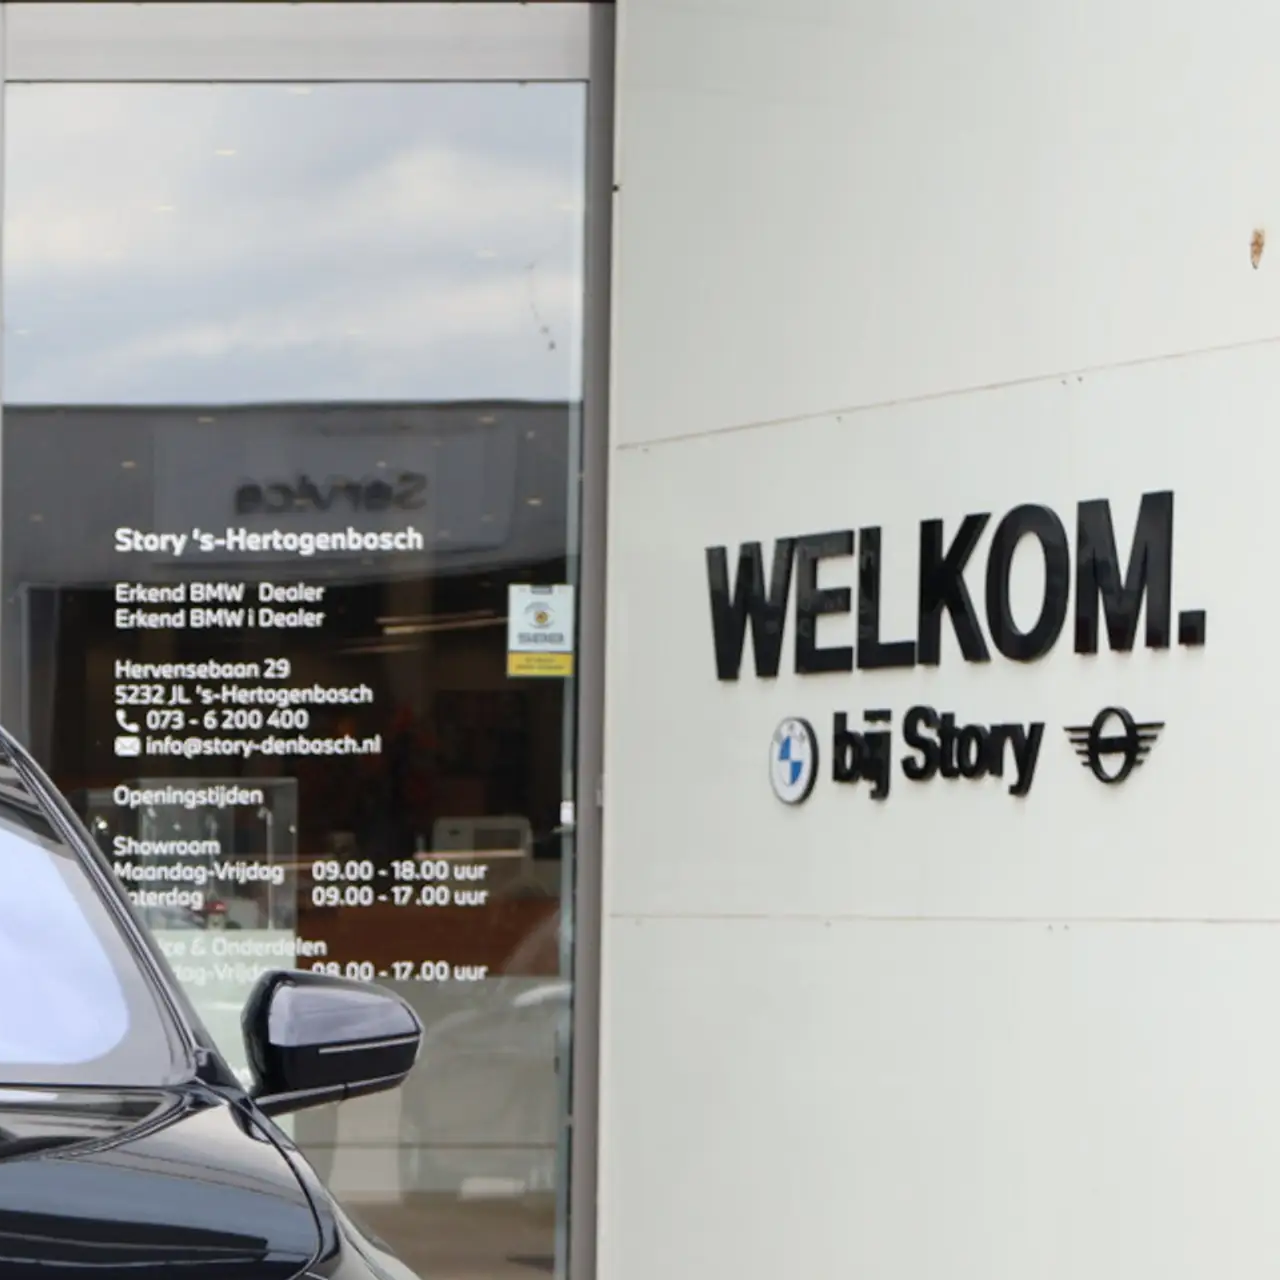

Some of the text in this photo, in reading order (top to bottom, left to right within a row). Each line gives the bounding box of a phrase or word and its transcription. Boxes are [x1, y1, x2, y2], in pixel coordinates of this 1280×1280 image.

[115, 527, 187, 557] Story
[115, 583, 326, 603] Erkend BMW Dealer
[705, 490, 1207, 681] WELKOM.
[115, 608, 326, 628] Erkend BMW i Dealer
[115, 659, 292, 680] Hervensebaan 29
[115, 684, 164, 704] 5232
[167, 684, 191, 706] JL
[146, 710, 185, 729] 073
[203, 710, 219, 729] 6
[221, 710, 264, 729] 200
[266, 710, 310, 729] 400
[146, 735, 382, 759] info@story-denbosch.nl
[900, 705, 1046, 797] Story
[113, 785, 265, 810] Openingstijden
[113, 836, 222, 856] Showroom
[114, 861, 285, 885] Maandag-Vrijdag
[312, 861, 373, 881] 09.00
[391, 861, 450, 881] 18.00
[453, 866, 488, 881] uur
[128, 886, 204, 911] aterdag
[312, 886, 373, 906] 09.00
[391, 886, 450, 906] 17.00
[453, 891, 489, 906] uur
[211, 936, 328, 957] Onderdelen
[312, 960, 375, 981] 0800
[391, 961, 450, 981] 17.00
[453, 966, 489, 981] uur
